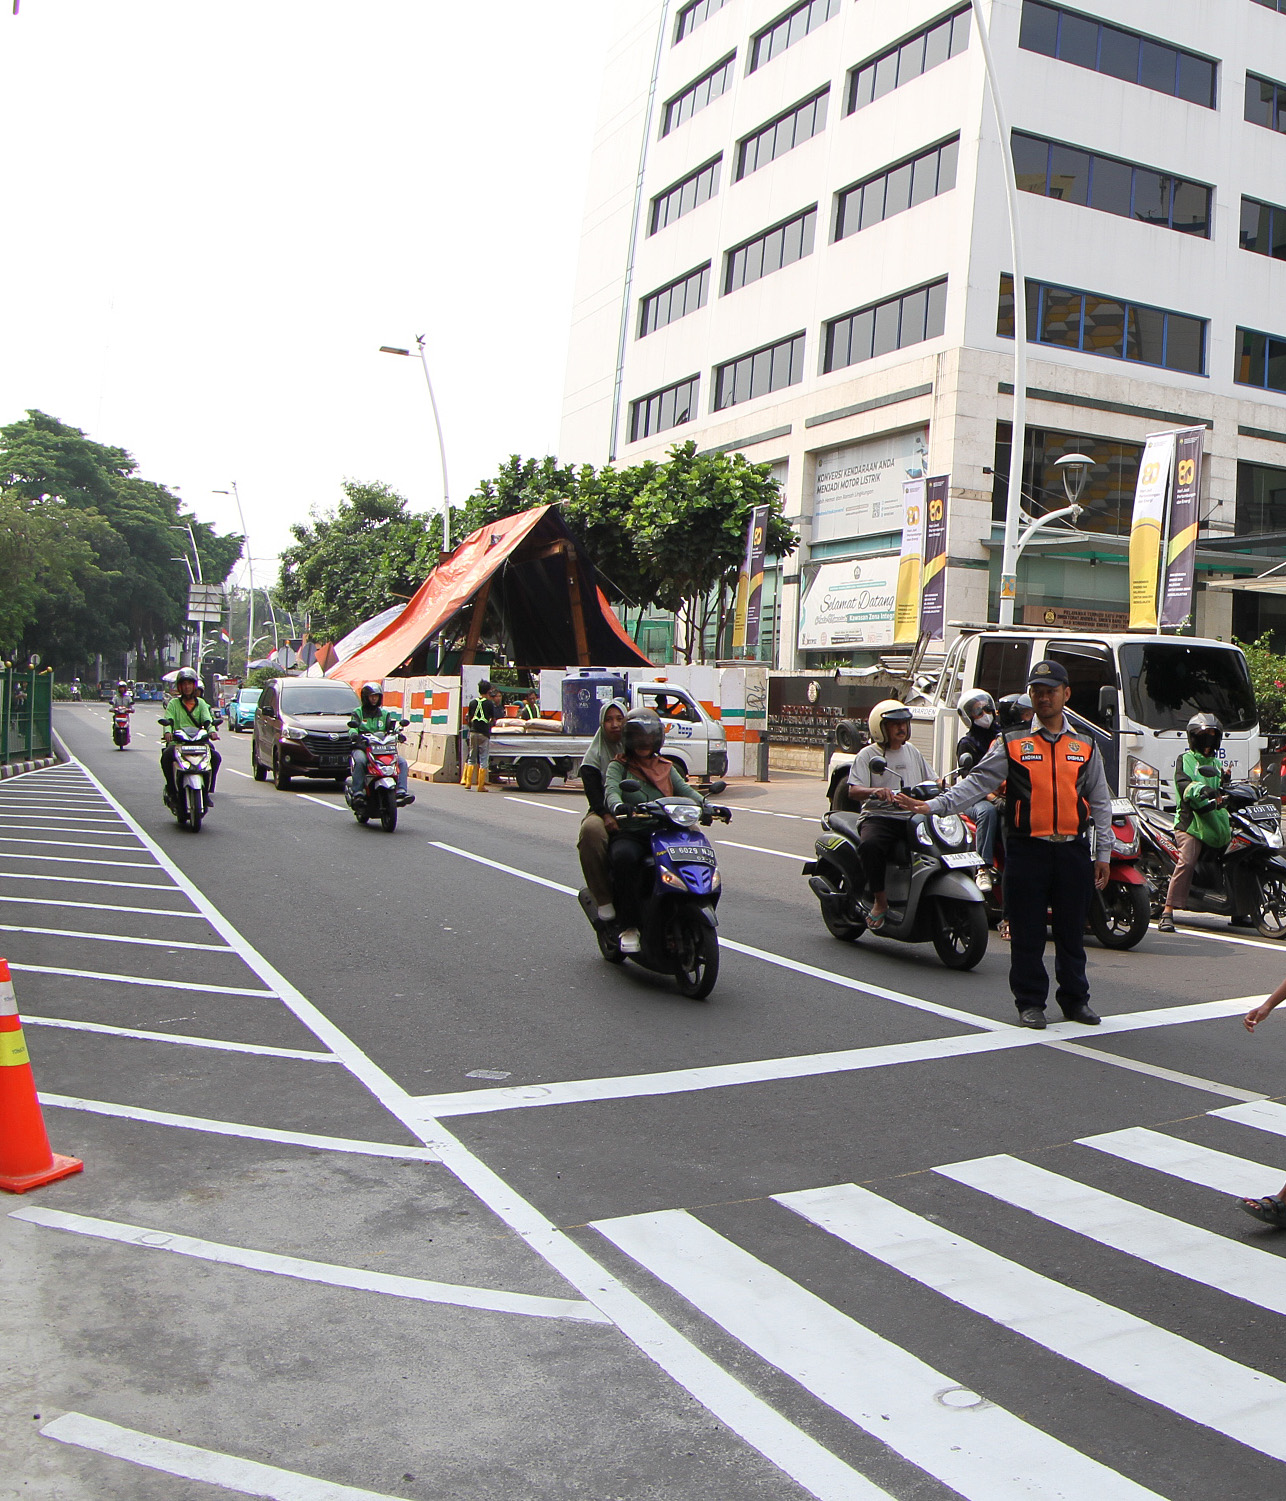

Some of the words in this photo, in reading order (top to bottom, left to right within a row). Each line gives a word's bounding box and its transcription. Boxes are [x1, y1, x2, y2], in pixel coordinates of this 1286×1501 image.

[817, 473, 843, 482] KONVERSI
[843, 462, 879, 476] KENDARAAN
[878, 458, 895, 469] ANDA
[1178, 458, 1195, 486] 80
[816, 482, 840, 494] MENJADI
[840, 477, 860, 488] MOTOR
[860, 473, 881, 485] LISTRIK
[820, 594, 857, 613] Selamat
[858, 590, 894, 612] Datang
[868, 612, 880, 620] Zona
[880, 612, 894, 620] Integr
[912, 708, 936, 716] WARDEN
